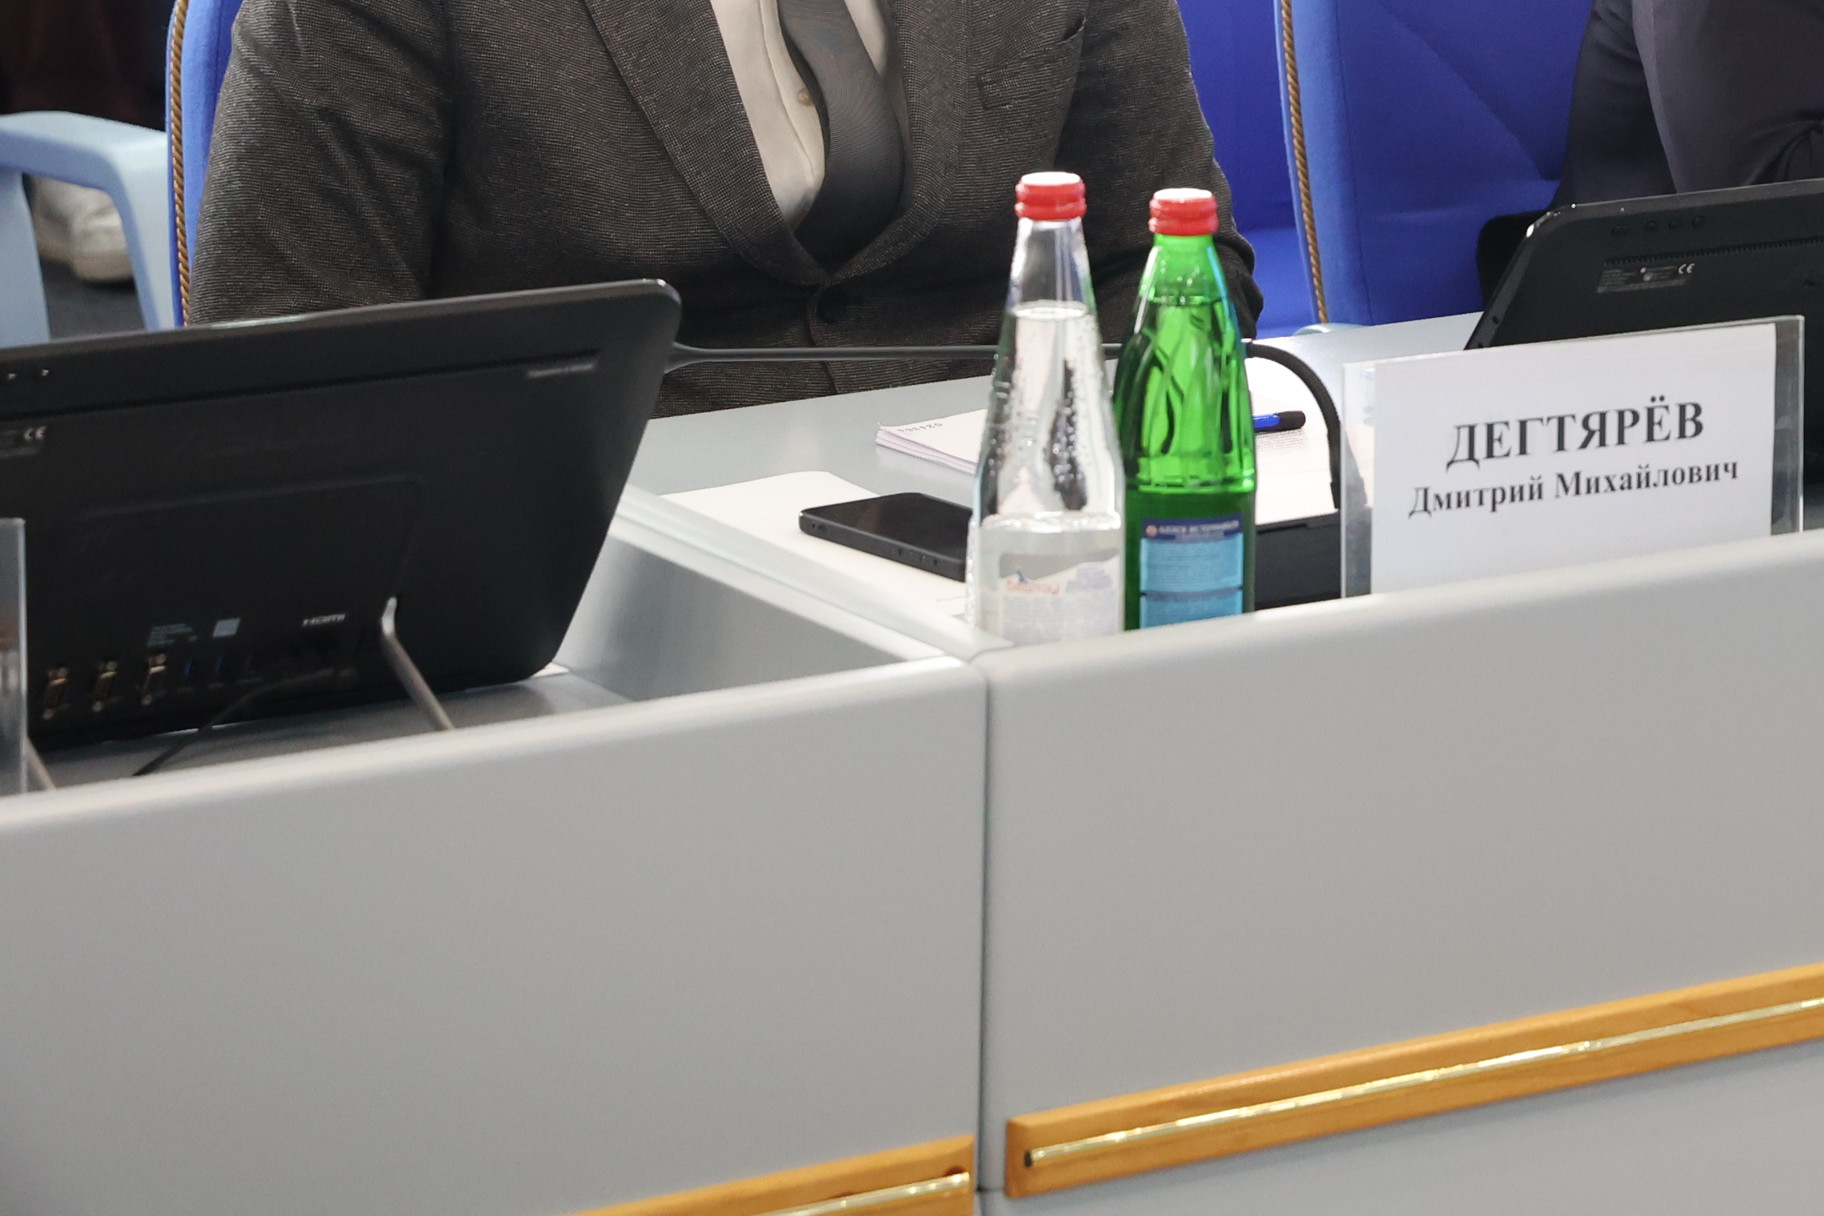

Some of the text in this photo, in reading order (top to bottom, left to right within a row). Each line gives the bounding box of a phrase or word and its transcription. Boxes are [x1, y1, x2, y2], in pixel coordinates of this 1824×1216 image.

[1445, 395, 1706, 472] ДЕГТЯРЁВ
[1407, 462, 1739, 519] Дмитрий Михайлович
